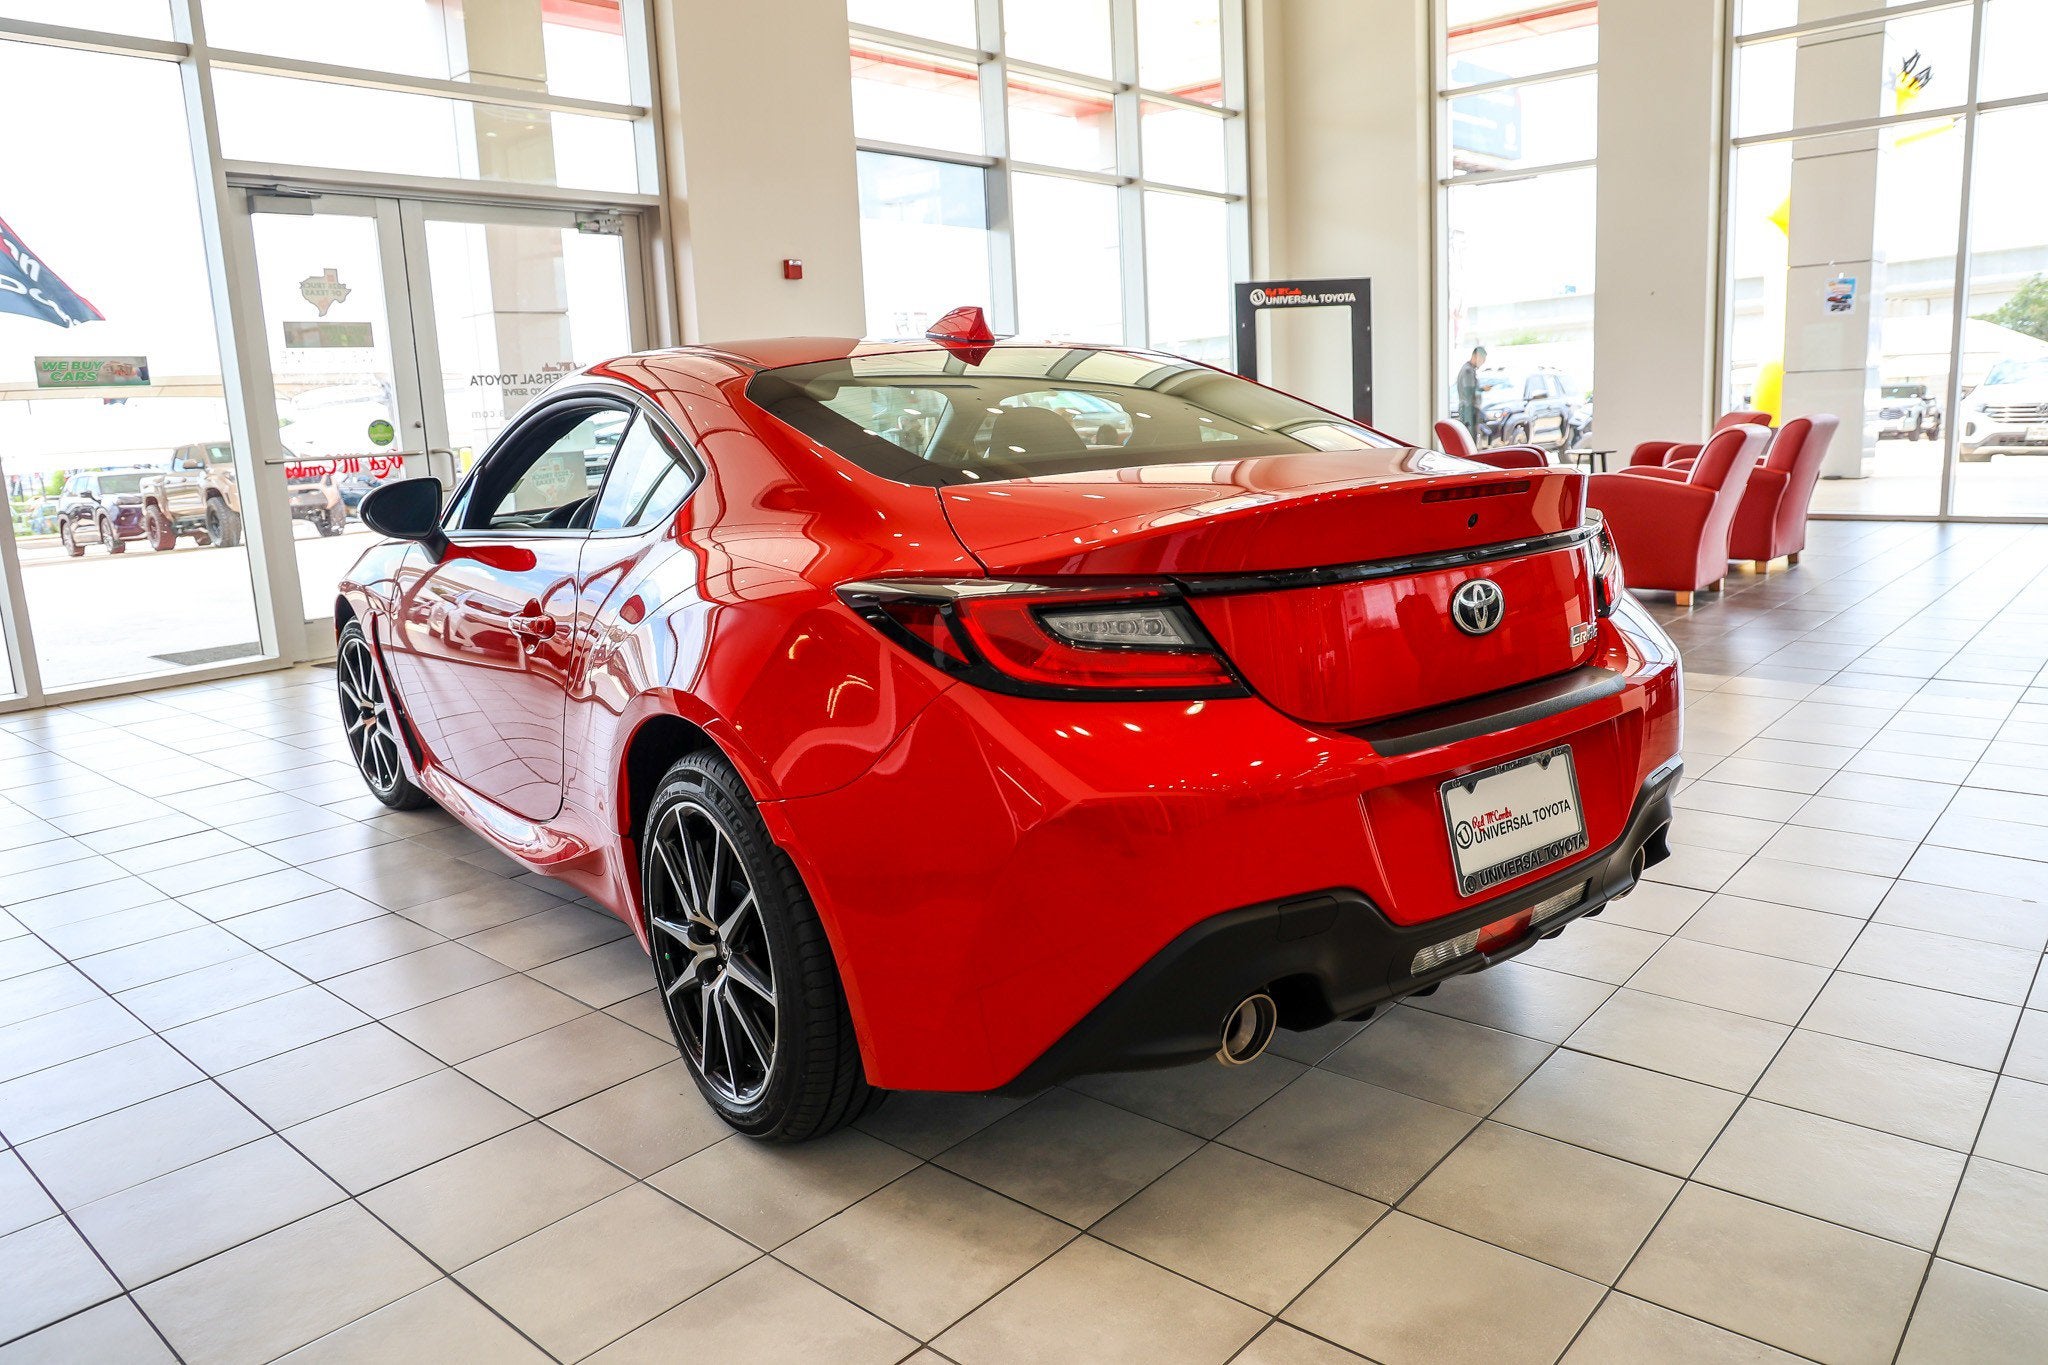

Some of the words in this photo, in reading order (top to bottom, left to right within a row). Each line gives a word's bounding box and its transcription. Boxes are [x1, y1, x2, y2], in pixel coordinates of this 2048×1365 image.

[1265, 294, 1319, 305] UNIVERSAL
[1319, 292, 1357, 303] TOYOTA
[42, 361, 69, 371] WE
[71, 361, 105, 371] BUY
[50, 371, 97, 382] CARS
[1471, 815, 1487, 832] Red
[1474, 812, 1533, 844] UNIVERSAL
[1532, 799, 1572, 823] TOYOTA
[1479, 851, 1545, 886] UNIVERSAL
[1544, 834, 1586, 861] TOYOTA
